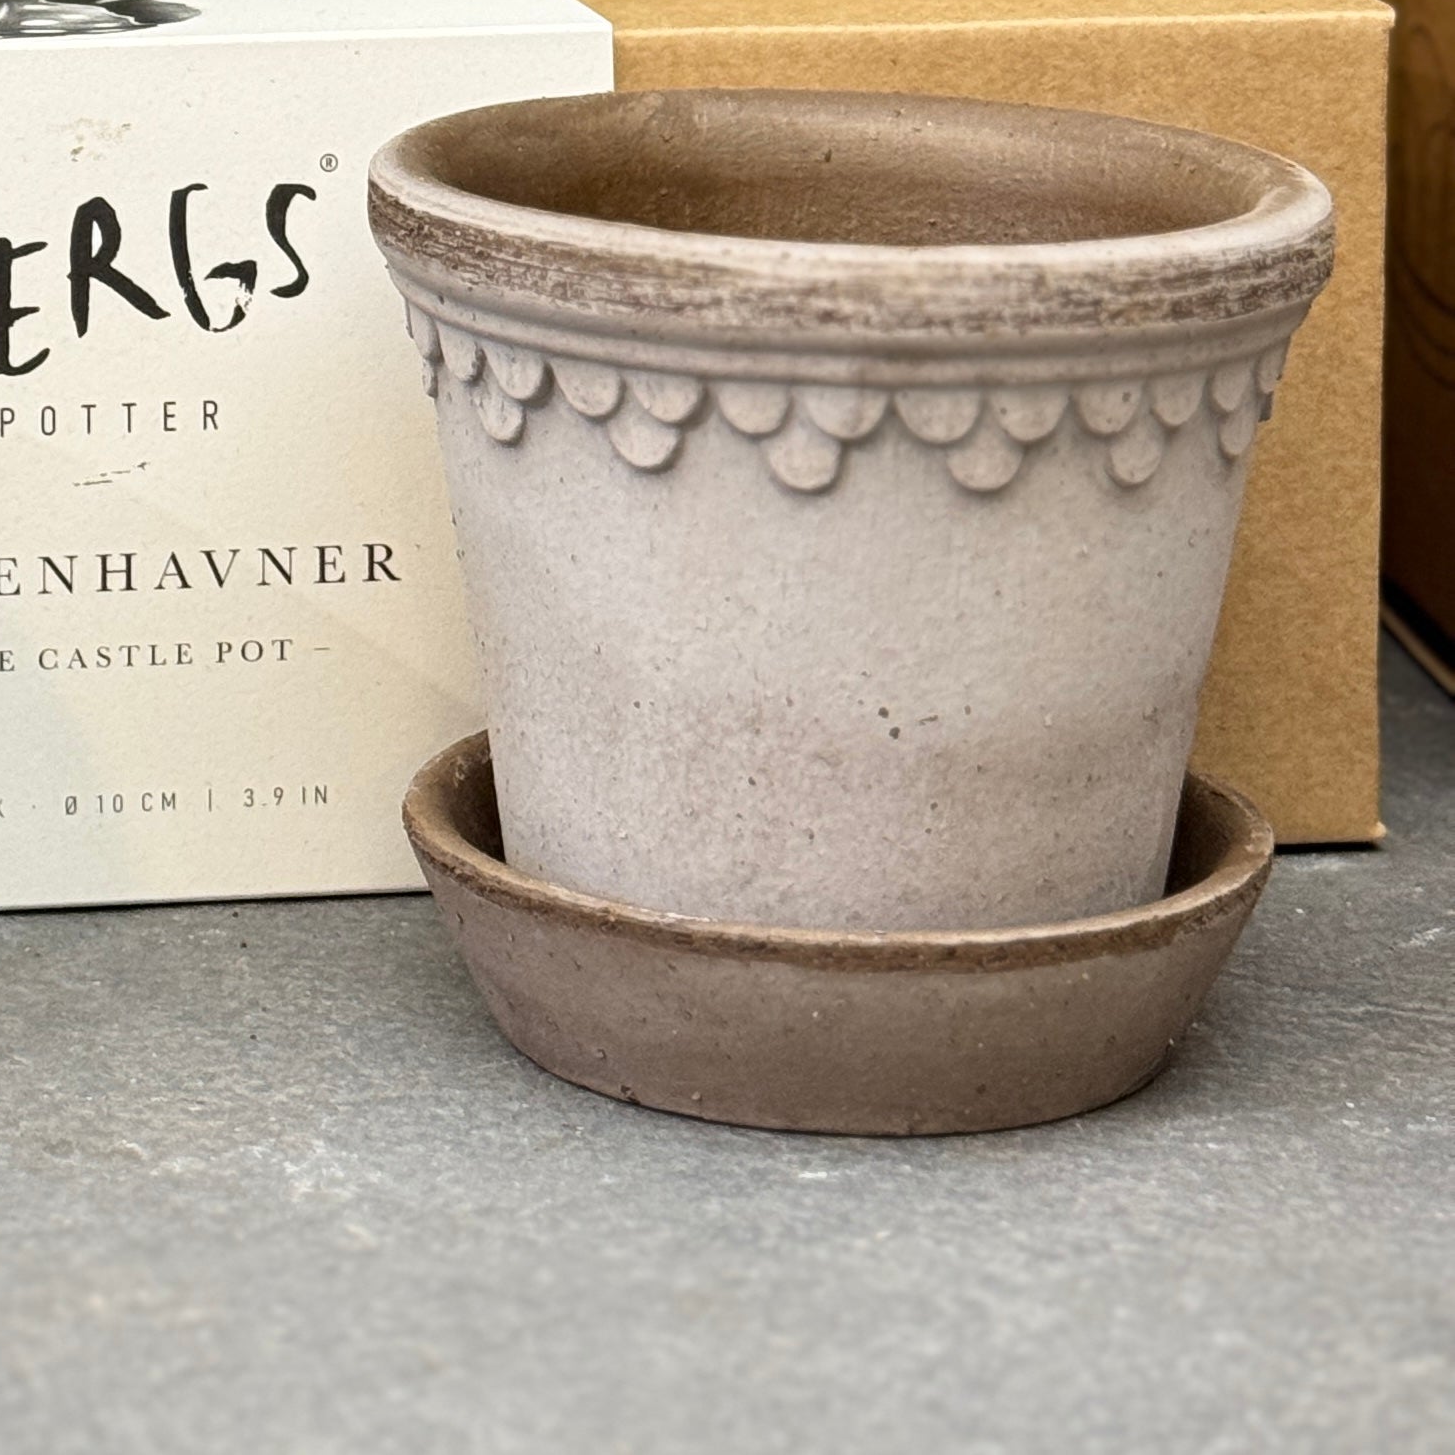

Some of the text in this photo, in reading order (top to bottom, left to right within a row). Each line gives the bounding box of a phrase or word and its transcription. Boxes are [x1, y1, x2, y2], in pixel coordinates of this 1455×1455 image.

[0, 399, 219, 439] POTTER
[38, 642, 194, 672] CASTLE
[214, 637, 294, 665] POT
[97, 793, 125, 815] 10
[141, 791, 178, 814] CM
[243, 786, 285, 809] 3.9
[301, 784, 329, 807] IN
